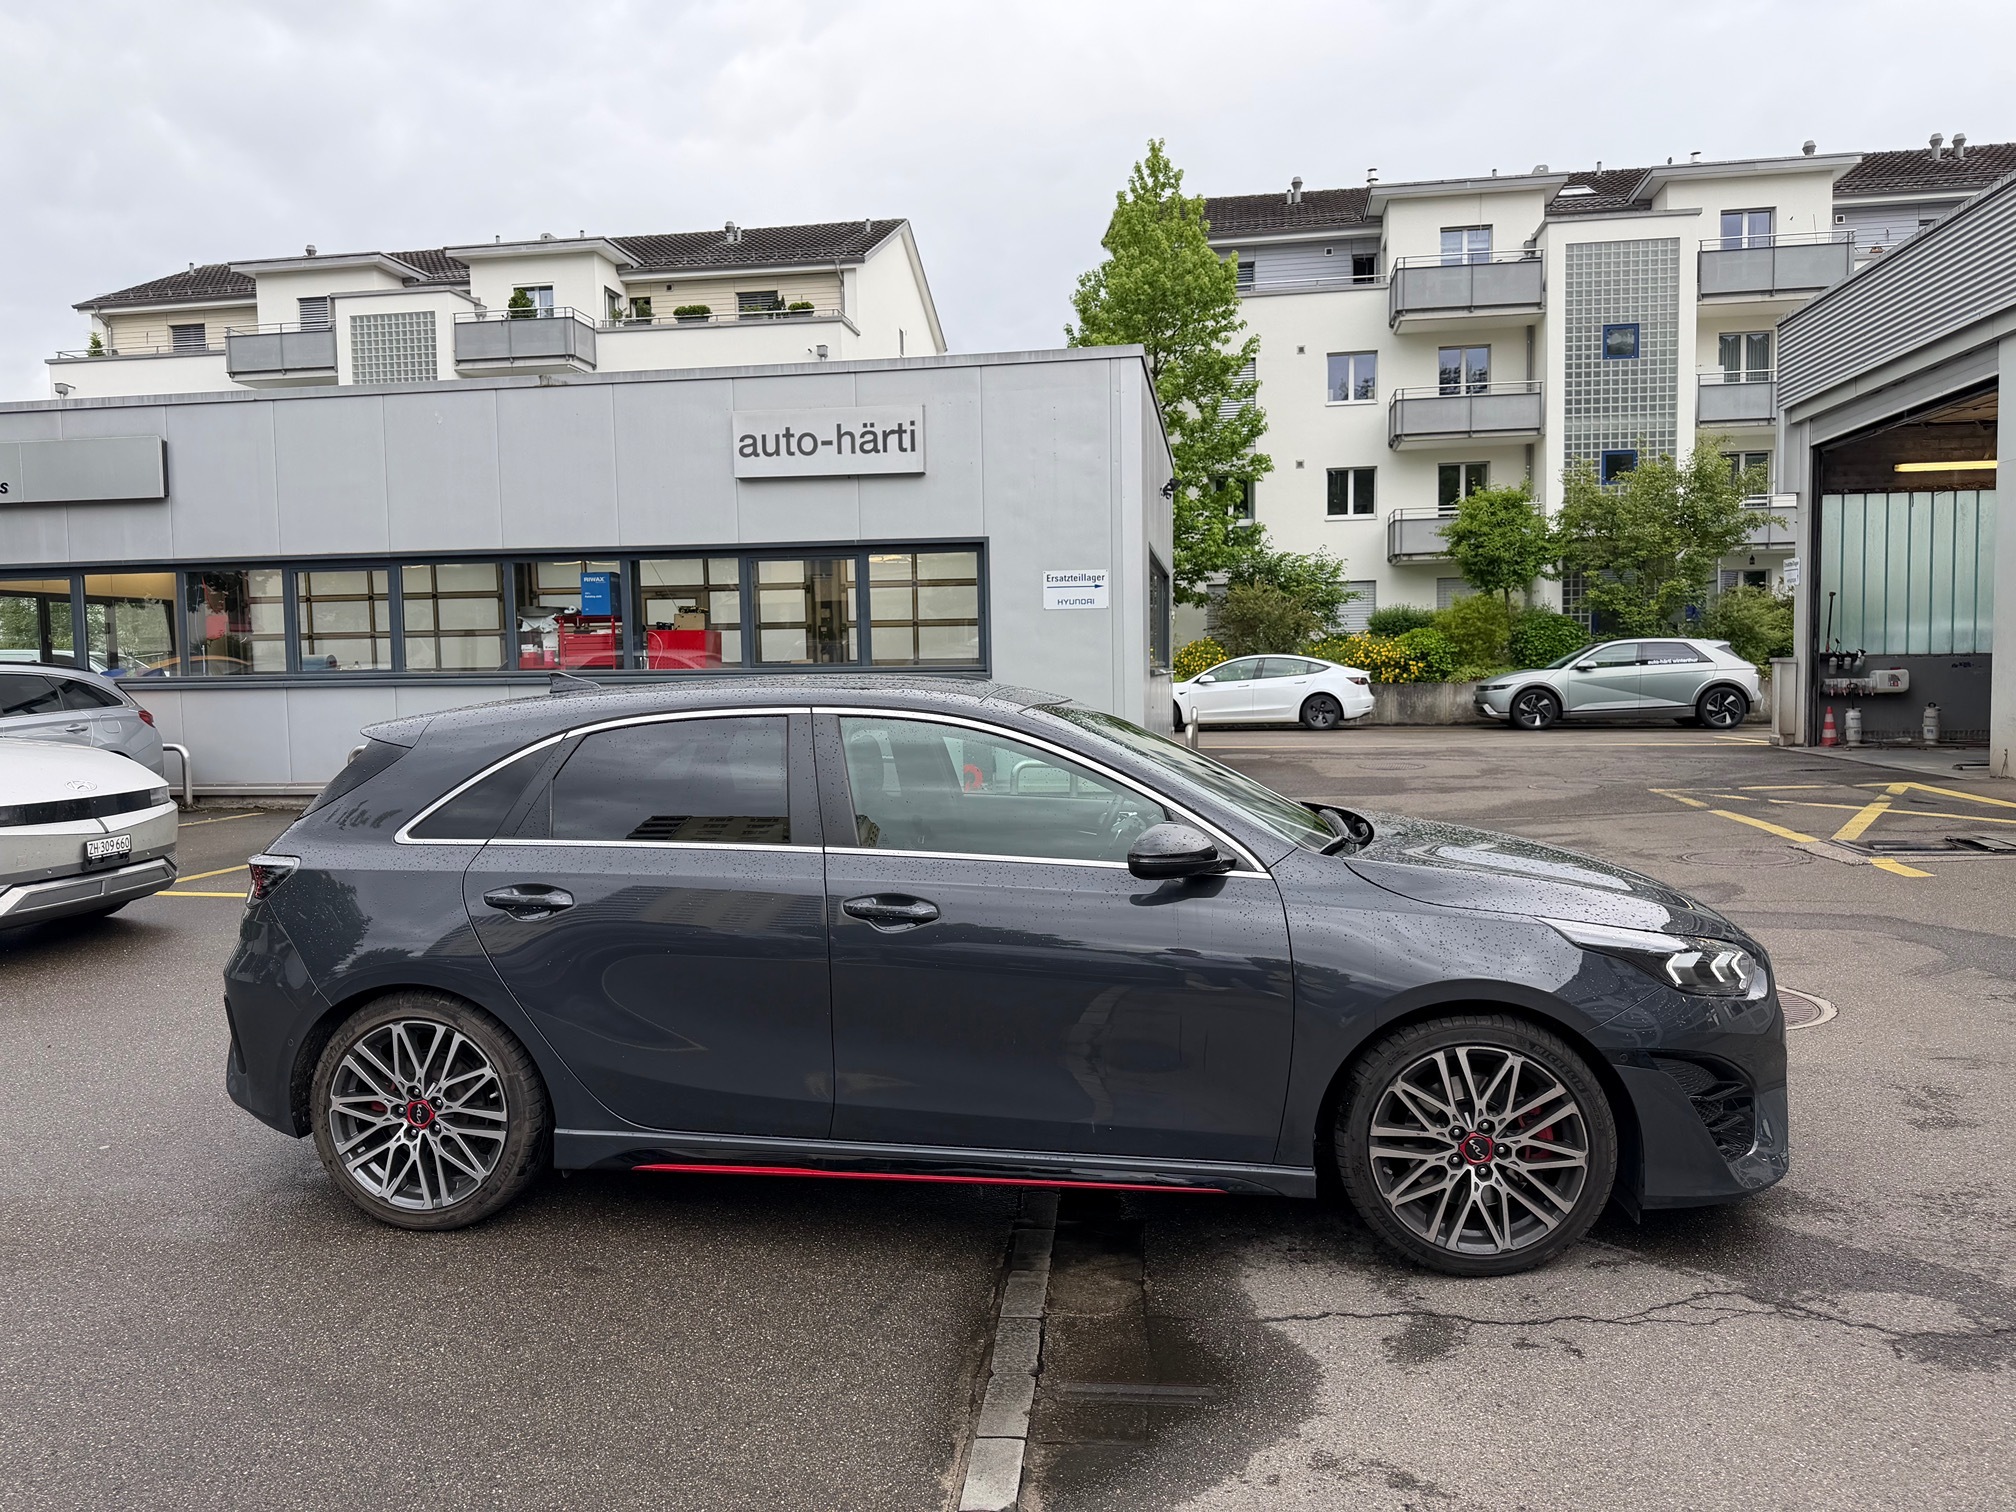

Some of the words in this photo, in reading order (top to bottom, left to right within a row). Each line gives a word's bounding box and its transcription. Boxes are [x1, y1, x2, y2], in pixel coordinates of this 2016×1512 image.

[738, 420, 916, 458] auto-härti
[1046, 573, 1105, 583] Ersatzteillager
[1532, 1043, 1587, 1094] MICHELIN
